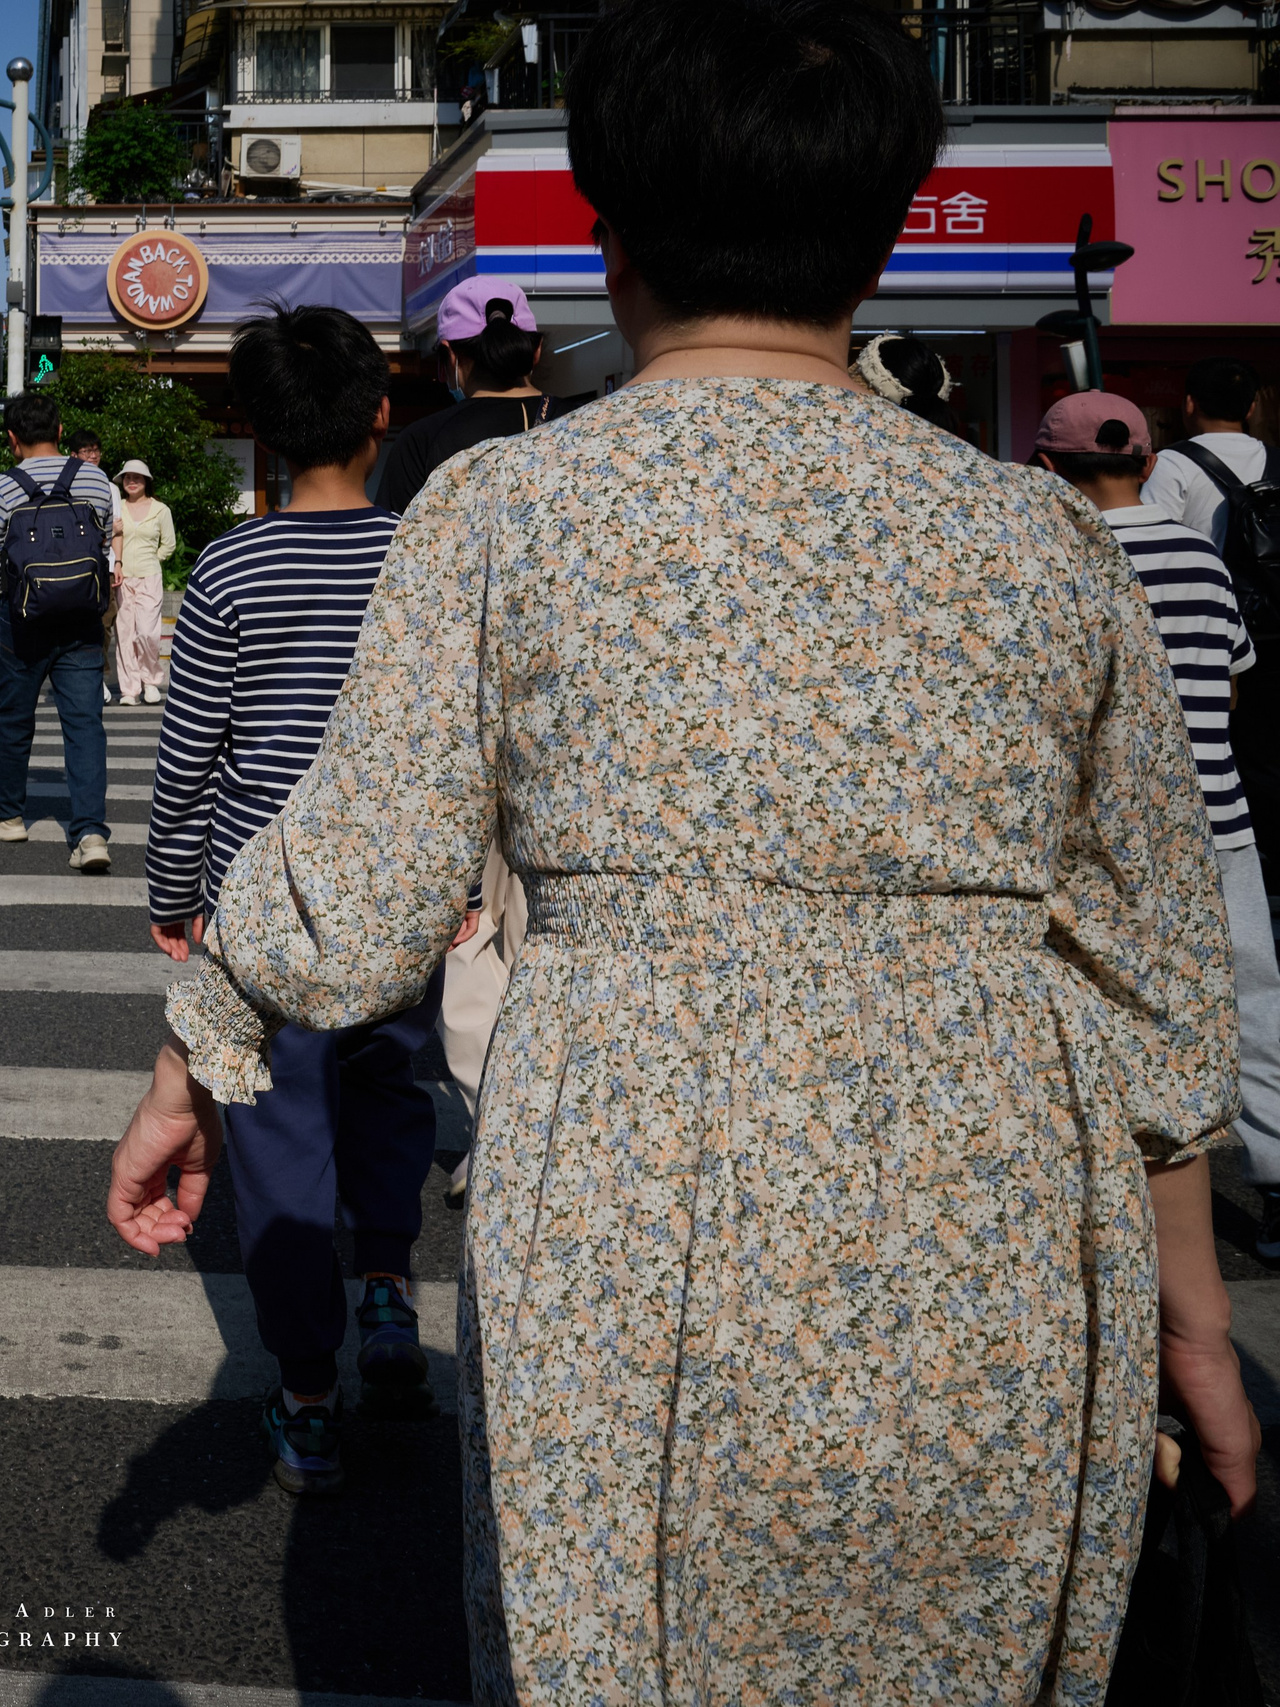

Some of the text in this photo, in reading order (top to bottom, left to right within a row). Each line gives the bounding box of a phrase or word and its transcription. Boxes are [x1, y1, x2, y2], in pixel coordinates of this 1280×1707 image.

[122, 242, 193, 314] BACK TO WANDAN
